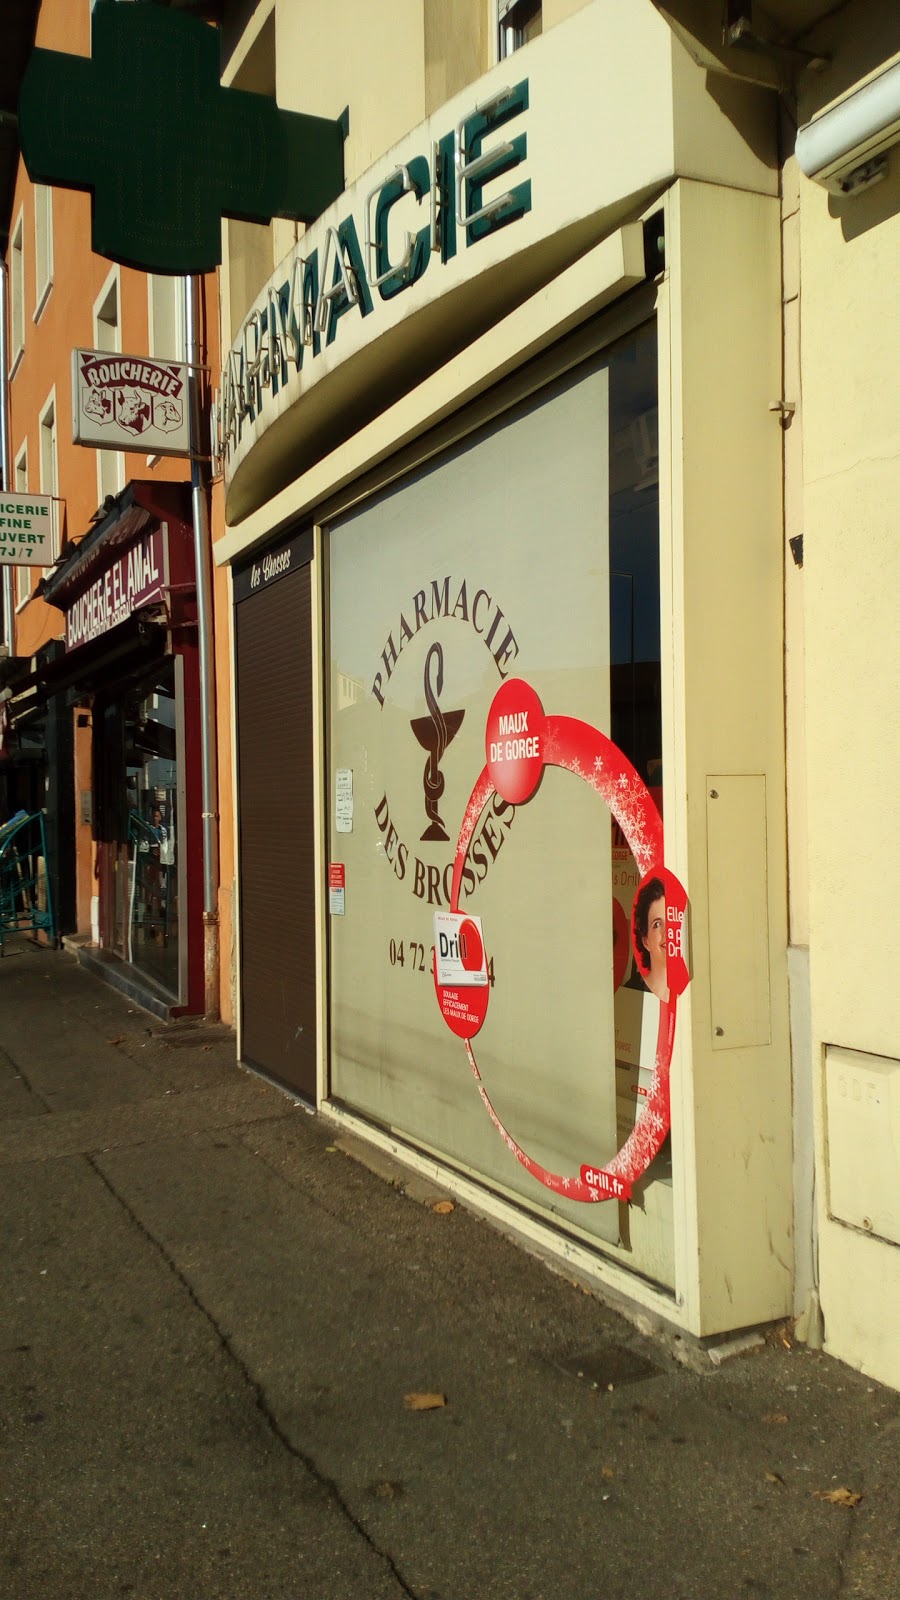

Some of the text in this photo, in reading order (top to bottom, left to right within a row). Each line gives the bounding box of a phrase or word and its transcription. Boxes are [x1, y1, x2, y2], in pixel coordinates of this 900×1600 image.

[87, 361, 179, 395] BOUCHERIE
[0, 517, 32, 529] FINE
[68, 569, 112, 648] BOUCHERIE
[113, 560, 126, 610] EL
[127, 534, 159, 600] AMAL
[371, 575, 520, 712] PHARMACIE
[499, 711, 528, 736] MAUX
[490, 736, 540, 763] DE GORGE
[374, 790, 410, 881] DES
[667, 906, 684, 923] Elle
[439, 932, 468, 960] Drill
[668, 928, 674, 940] a
[389, 938, 405, 968] 04
[410, 941, 426, 972] 72
[442, 989, 459, 1001] SOULAGE
[585, 1168, 624, 1196] drill.fr
